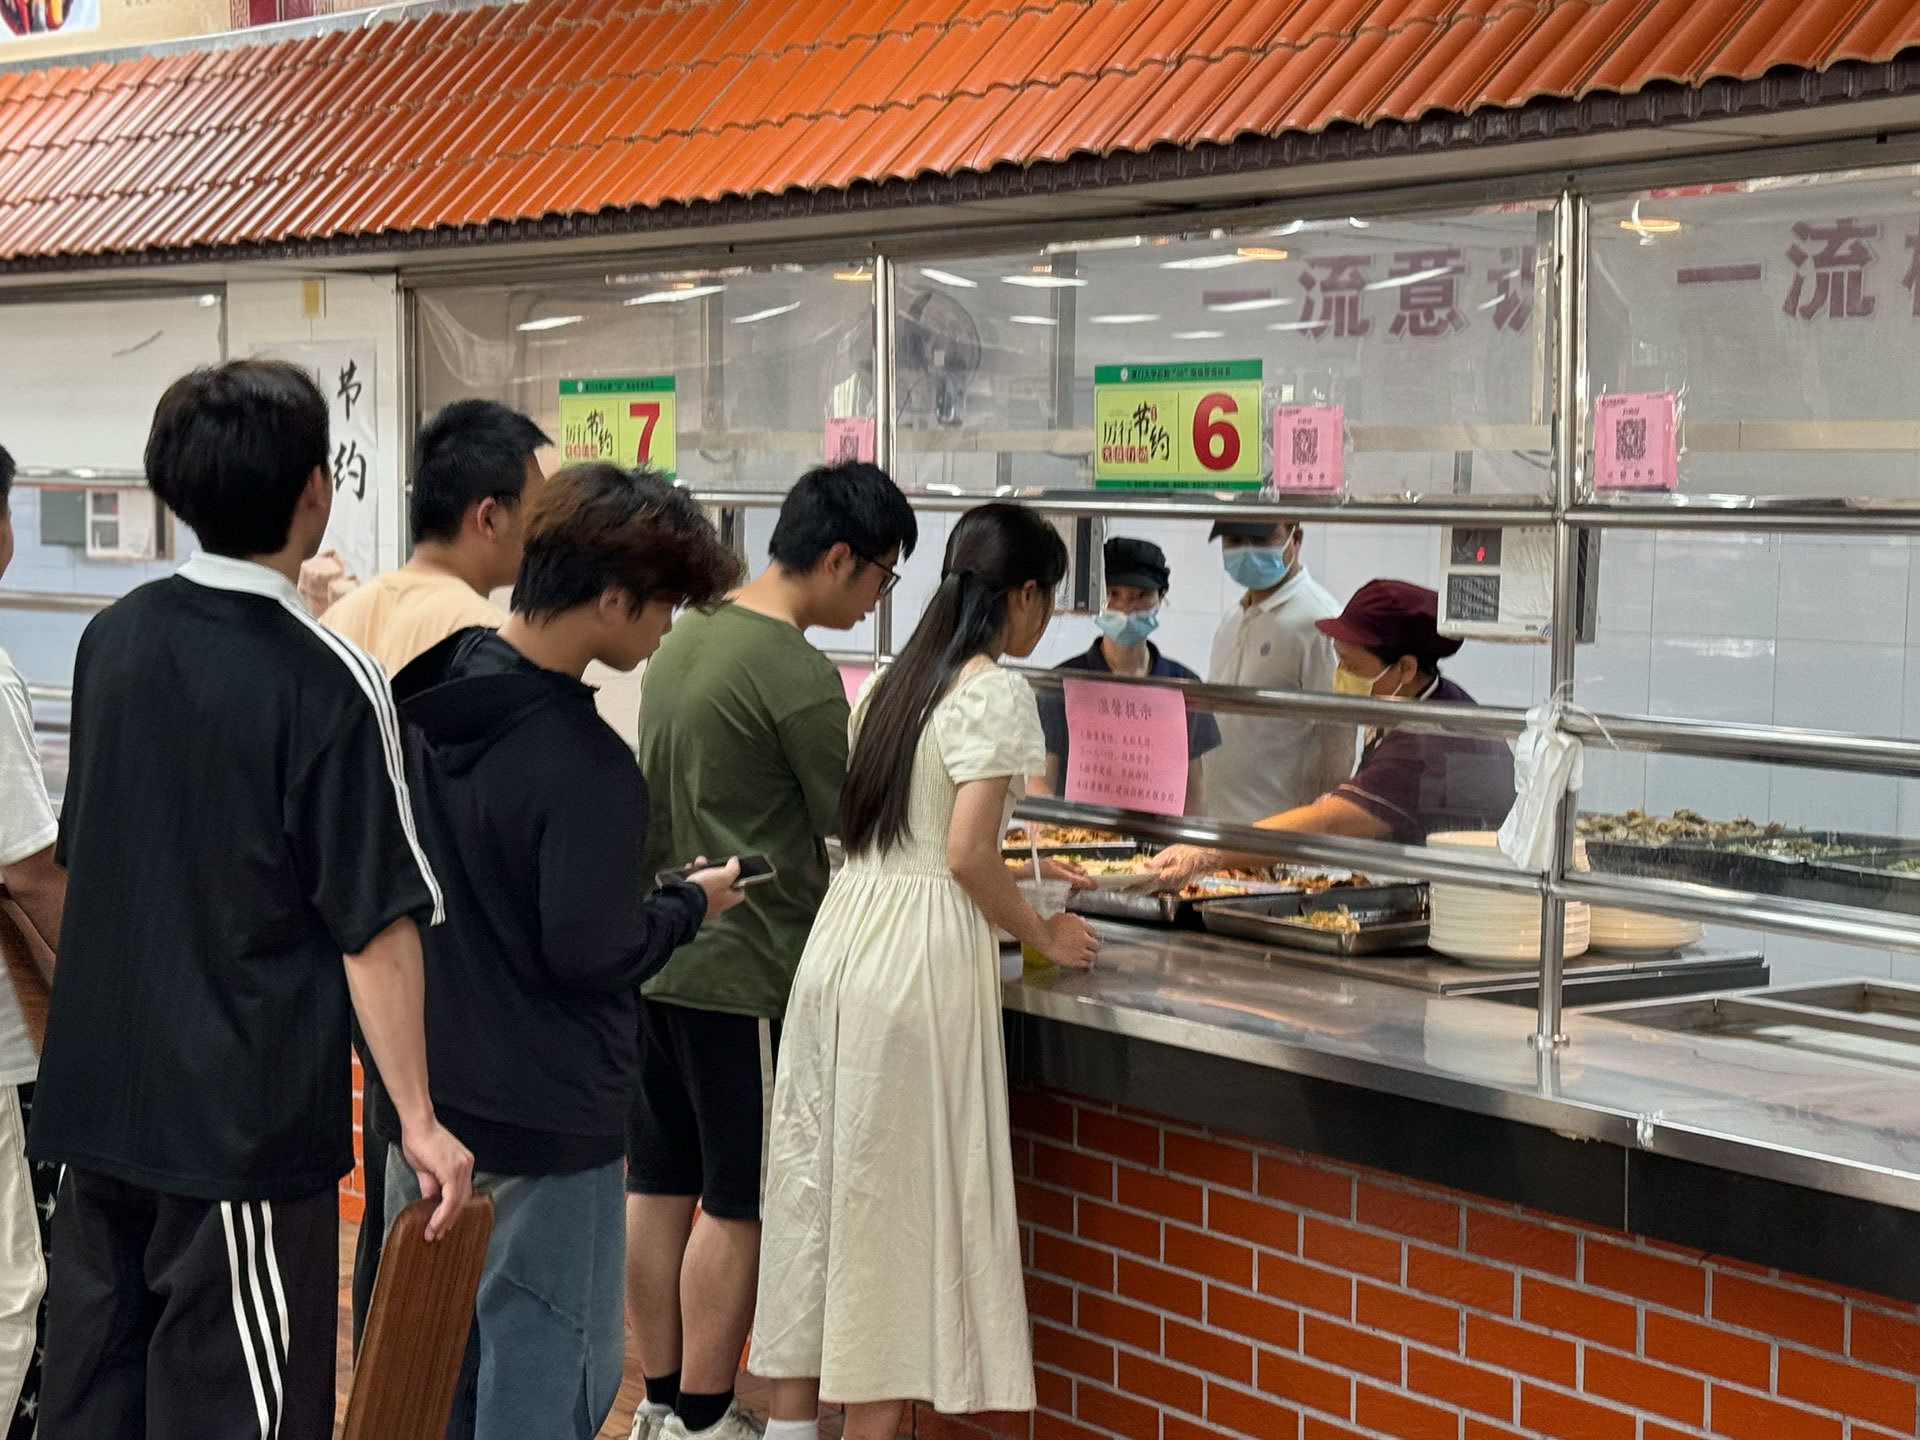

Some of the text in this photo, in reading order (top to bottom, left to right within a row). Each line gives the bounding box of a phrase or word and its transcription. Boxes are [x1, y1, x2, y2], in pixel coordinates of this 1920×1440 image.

[1677, 217, 1920, 320] 一流
[334, 358, 366, 503] 节约
[630, 402, 660, 465] 7
[1193, 392, 1240, 471] 6
